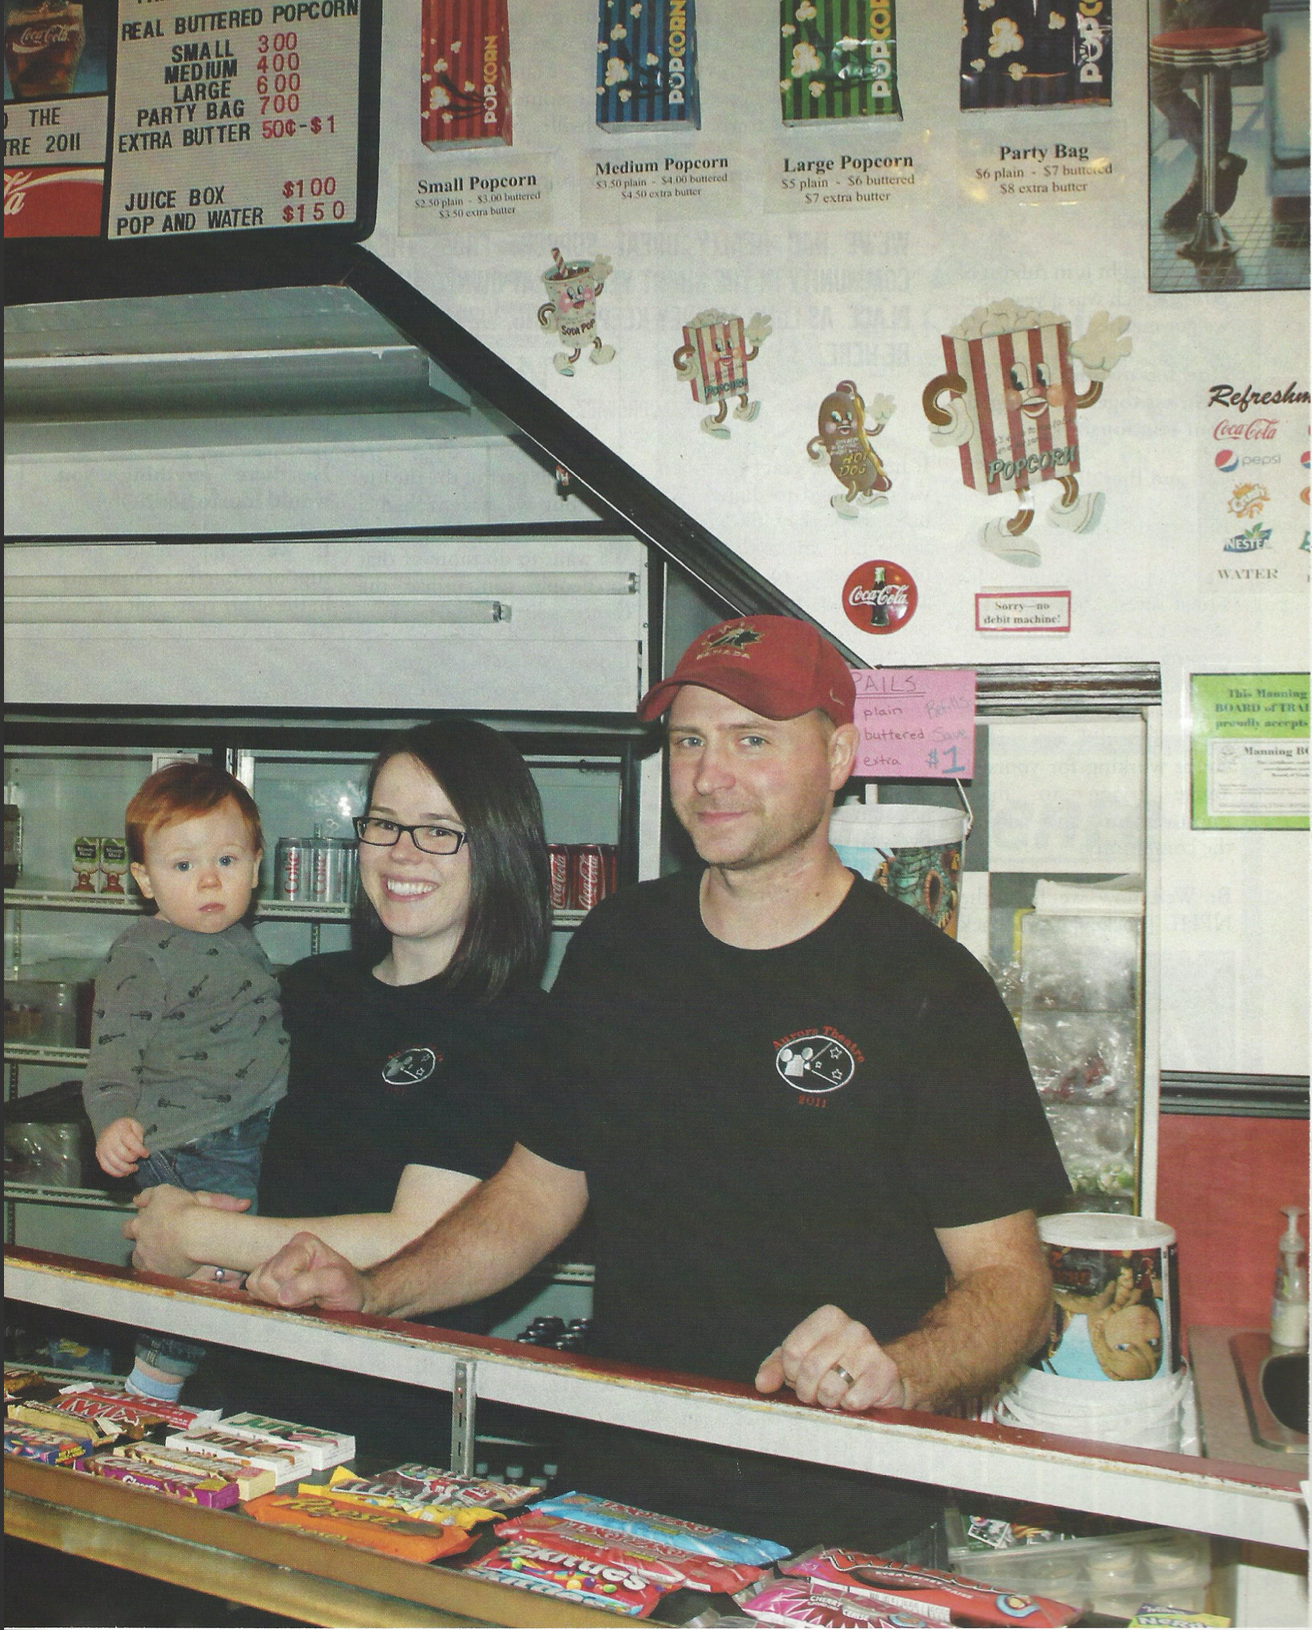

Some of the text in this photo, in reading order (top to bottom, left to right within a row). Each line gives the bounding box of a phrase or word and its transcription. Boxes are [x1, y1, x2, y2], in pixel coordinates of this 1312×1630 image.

[122, 0, 359, 42] REAL BUTTERED POPCORN
[171, 32, 299, 64] SMALL 300
[1079, 0, 1106, 84] POPC
[668, 0, 687, 105] POPCORN
[163, 52, 300, 84] MEDIUM 400
[173, 73, 302, 103] LARGE 600
[483, 35, 498, 124] POPCORN
[29, 107, 62, 127] THE
[136, 93, 300, 127] PARTY BAG 700
[46, 132, 82, 153] 2011
[118, 130, 173, 153] EXTRA
[182, 122, 252, 147] BUTTER
[1000, 143, 1090, 163] Party Bag
[594, 156, 729, 176] Medium Popcorn
[783, 154, 914, 176] Large Popcorn
[975, 168, 991, 180] $6
[994, 166, 1025, 181] plain
[1043, 165, 1059, 177] $7
[1062, 163, 1113, 176] buttered
[417, 173, 538, 195] Small Popcorn
[596, 179, 622, 190] $3.50
[623, 177, 647, 190] plain
[661, 174, 687, 186] $4.00
[689, 173, 728, 184] buttered
[781, 178, 797, 190] $5
[799, 176, 830, 190] plain
[847, 175, 864, 187] $6
[865, 173, 915, 186] buttered
[999, 181, 1088, 195] $8 extra butter
[124, 176, 337, 212] JUICE BOX $100
[415, 198, 440, 209] $2.50
[441, 196, 464, 208] plain
[477, 193, 503, 205] $3.00
[503, 190, 542, 203] buttered
[621, 186, 702, 200] $4.50 extra butter
[805, 190, 891, 205] $7 extra butter
[116, 199, 346, 236] POP AND WATER $150
[439, 204, 516, 220] $3.50 extra butter
[561, 324, 581, 336] SODA
[581, 318, 597, 333] POP
[988, 444, 1078, 484] POPCORN
[1241, 454, 1281, 467] pepsi
[838, 464, 868, 477] DOG
[1218, 568, 1279, 580] WATER
[984, 613, 1061, 624] debit machine!
[852, 672, 917, 692] PAILS
[1228, 688, 1308, 700] This Manning
[864, 705, 902, 721] plain
[1215, 703, 1261, 713] BOARD
[1265, 702, 1277, 713] of
[1216, 717, 1308, 731] proudly accepts
[865, 729, 925, 742] buttered
[864, 755, 902, 767] extra
[925, 746, 966, 775] $1
[1244, 746, 1293, 757] Manning
[772, 1025, 865, 1063] Aurora Theatre
[798, 1095, 826, 1108] 2011
[809, 1595, 843, 1608] CHERRY
